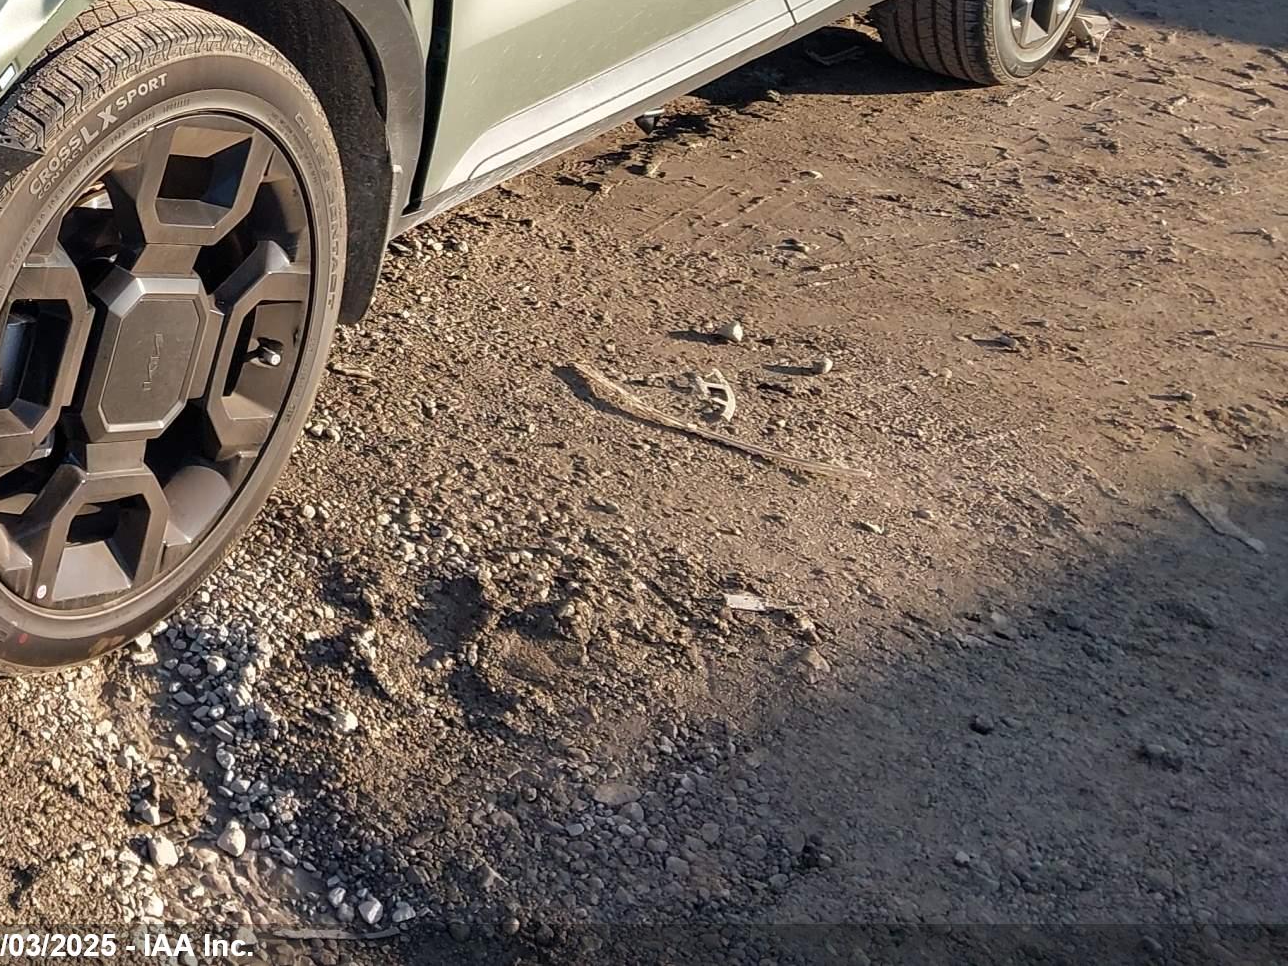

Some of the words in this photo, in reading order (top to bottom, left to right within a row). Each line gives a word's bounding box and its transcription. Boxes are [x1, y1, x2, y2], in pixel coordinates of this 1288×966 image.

[29, 133, 82, 195] CROSS
[116, 72, 168, 111] SPORT
[38, 144, 85, 200] CONTACT
